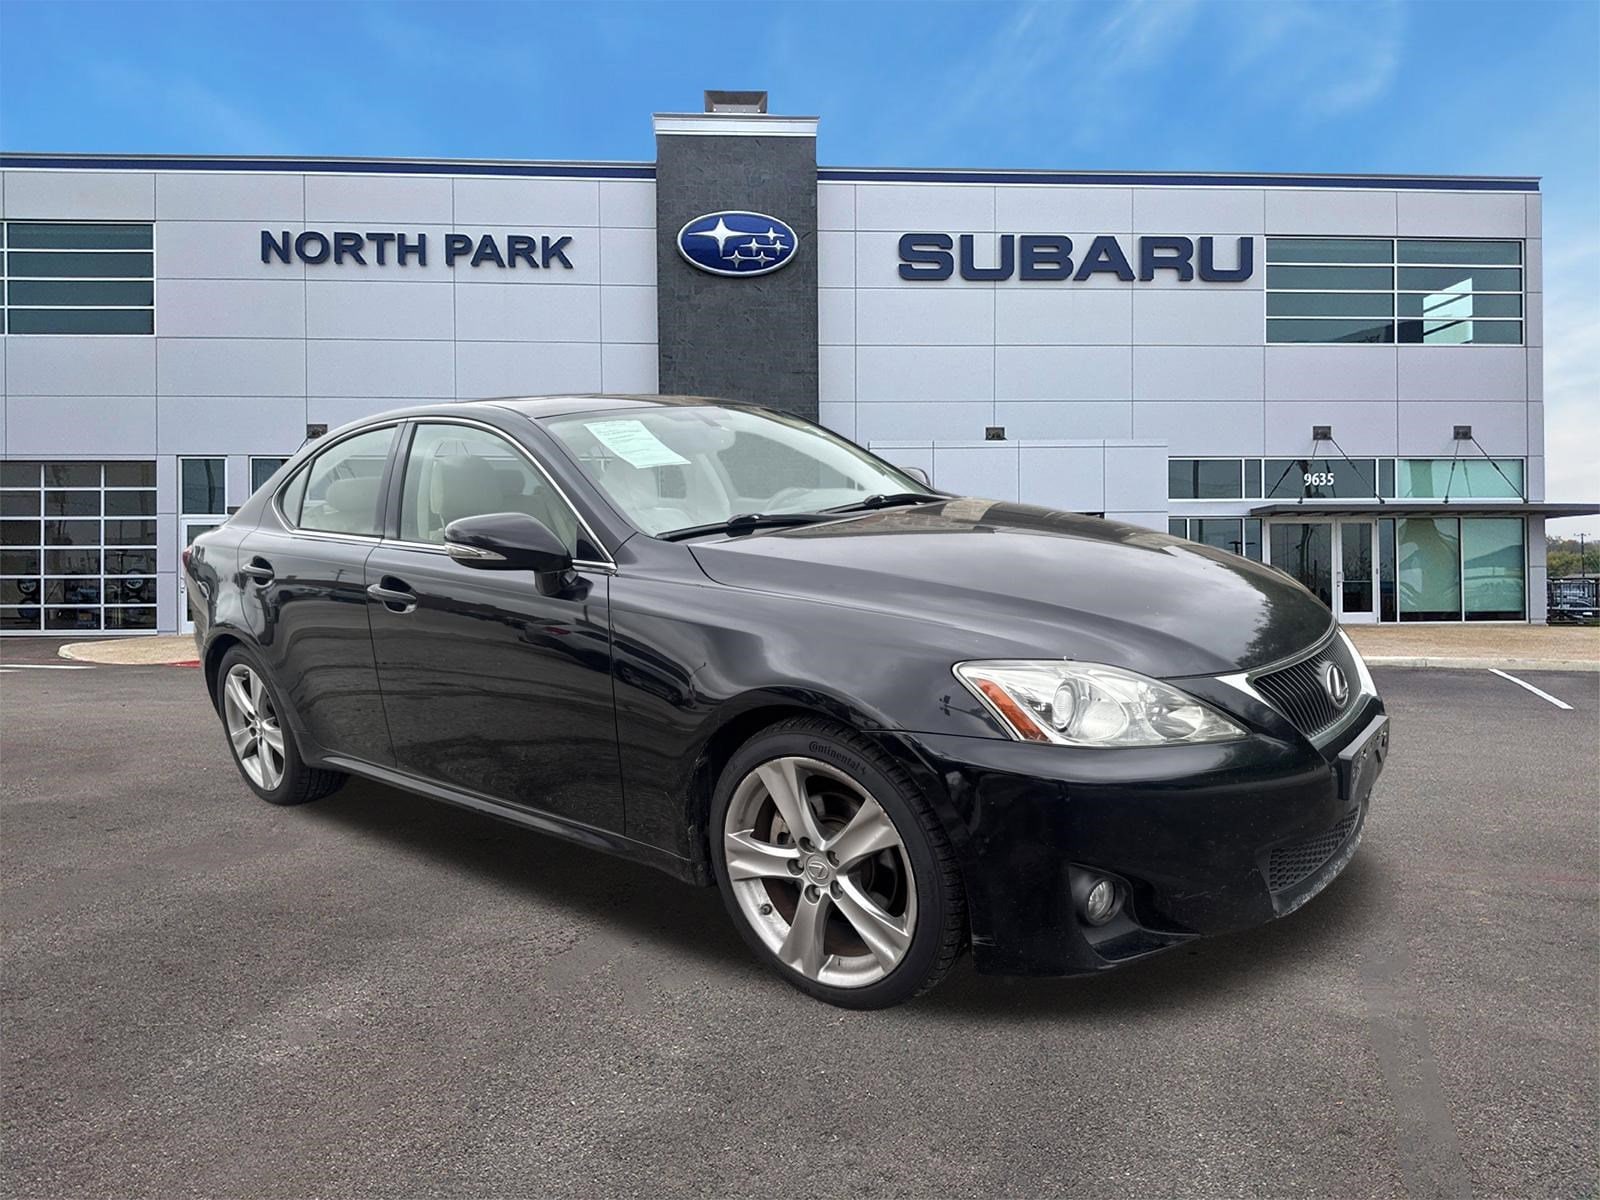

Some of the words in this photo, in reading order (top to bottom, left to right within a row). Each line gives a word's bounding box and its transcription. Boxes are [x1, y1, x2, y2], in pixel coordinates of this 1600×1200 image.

[260, 230, 428, 266] NORTH
[444, 233, 574, 269] PARK
[898, 232, 1255, 283] SUBARU
[1303, 472, 1335, 487] 9635
[808, 741, 861, 772] Continental
